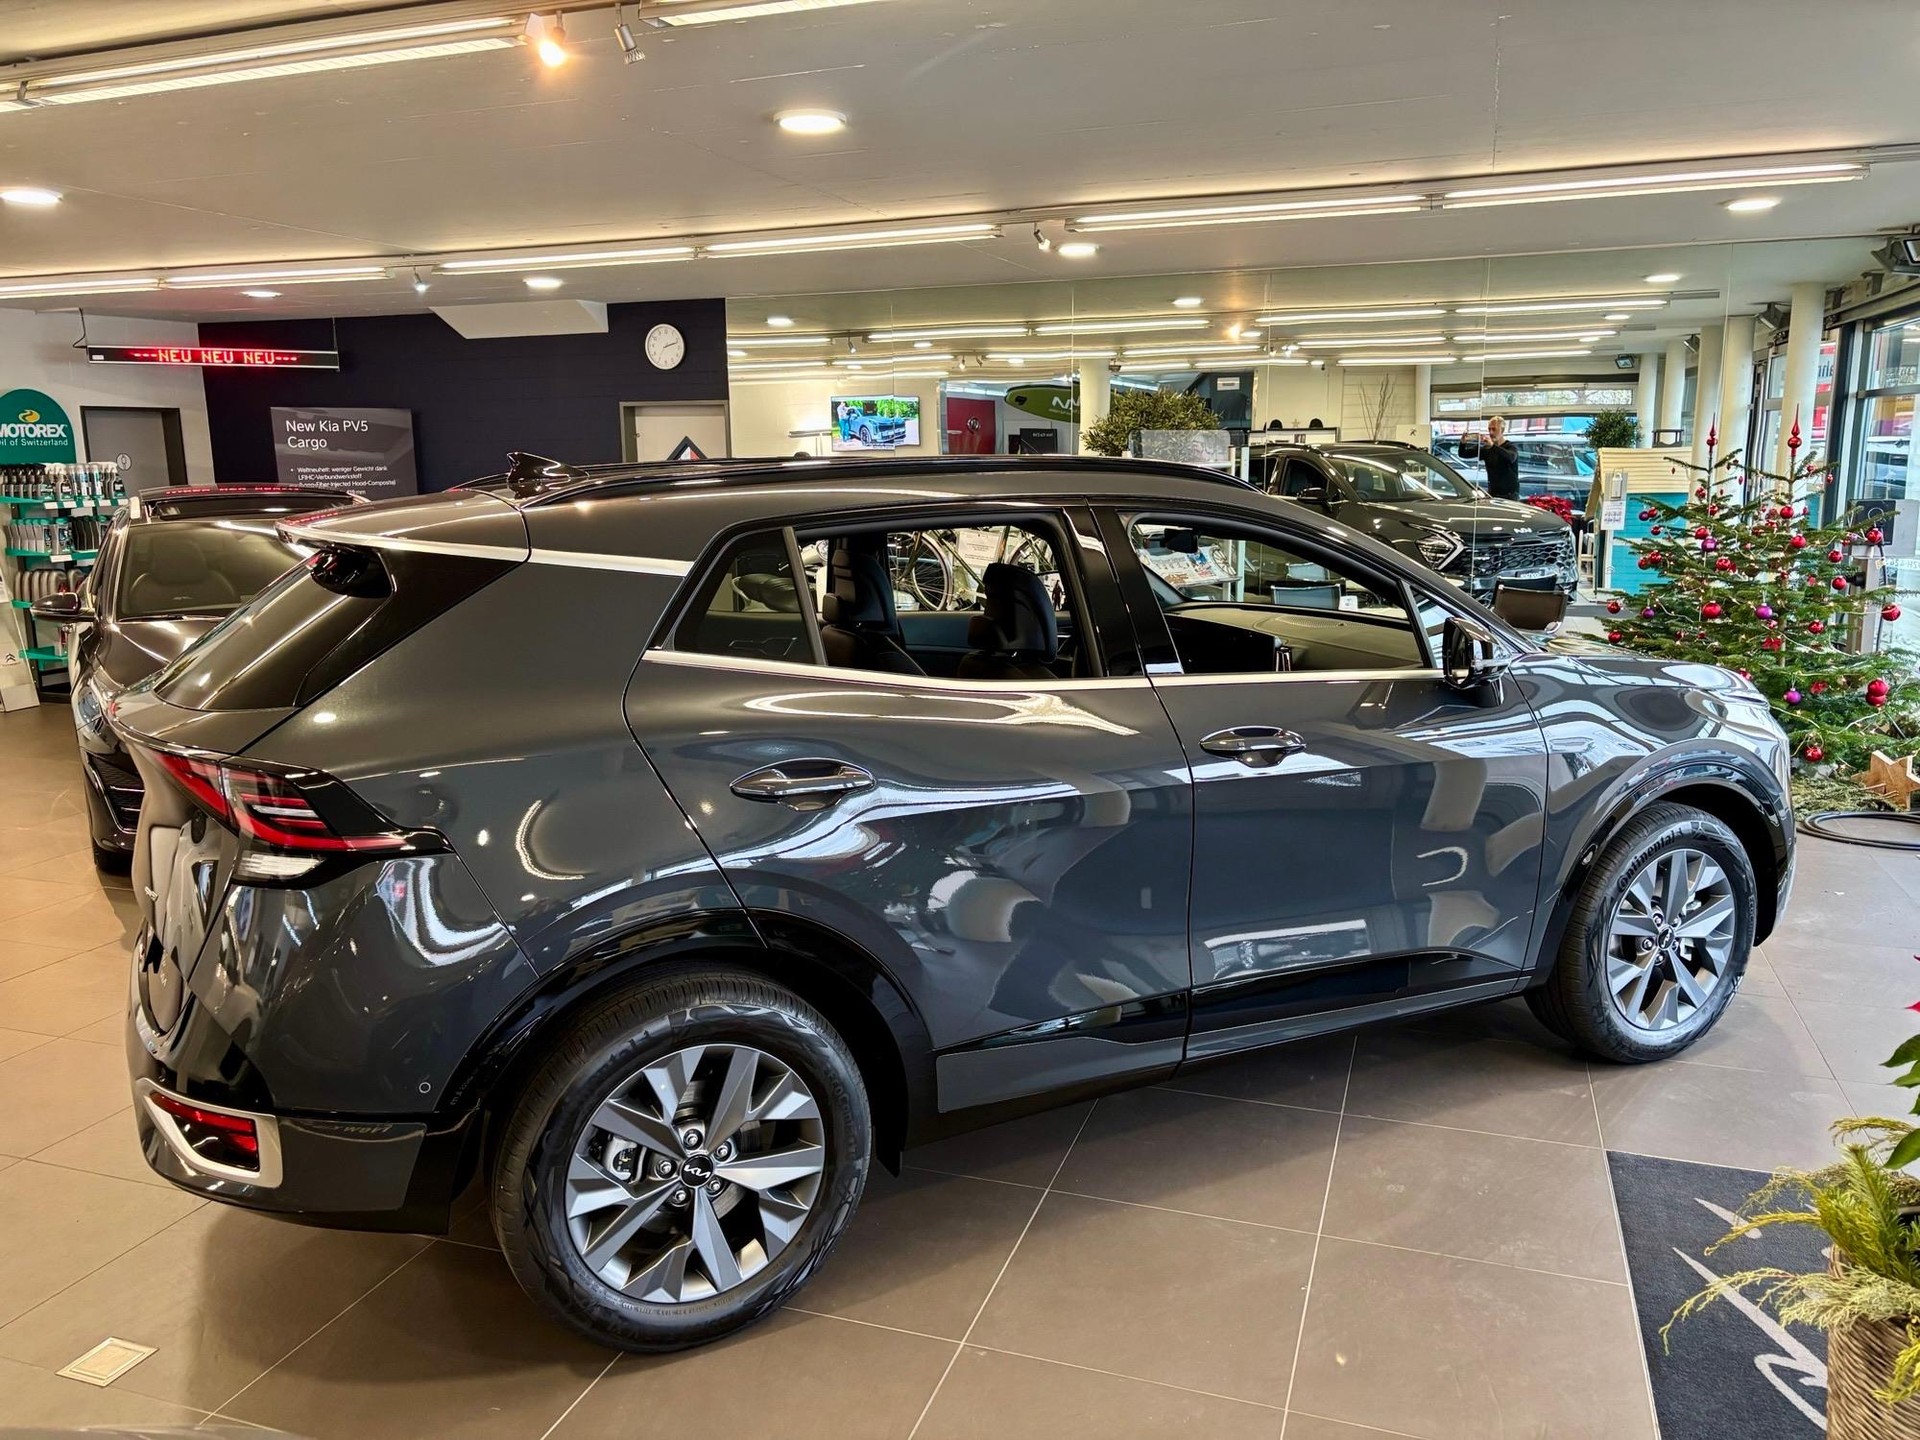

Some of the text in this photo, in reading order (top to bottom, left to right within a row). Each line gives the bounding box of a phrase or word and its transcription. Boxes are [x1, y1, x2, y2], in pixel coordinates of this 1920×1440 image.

[201, 350, 234, 363] NEU
[0, 423, 67, 438] MOTOREX
[285, 419, 369, 432] New Kia PV5
[9, 438, 18, 446] of
[21, 438, 69, 446] Switzerland
[287, 436, 328, 451] Cargo
[1616, 830, 1676, 893] Continental
